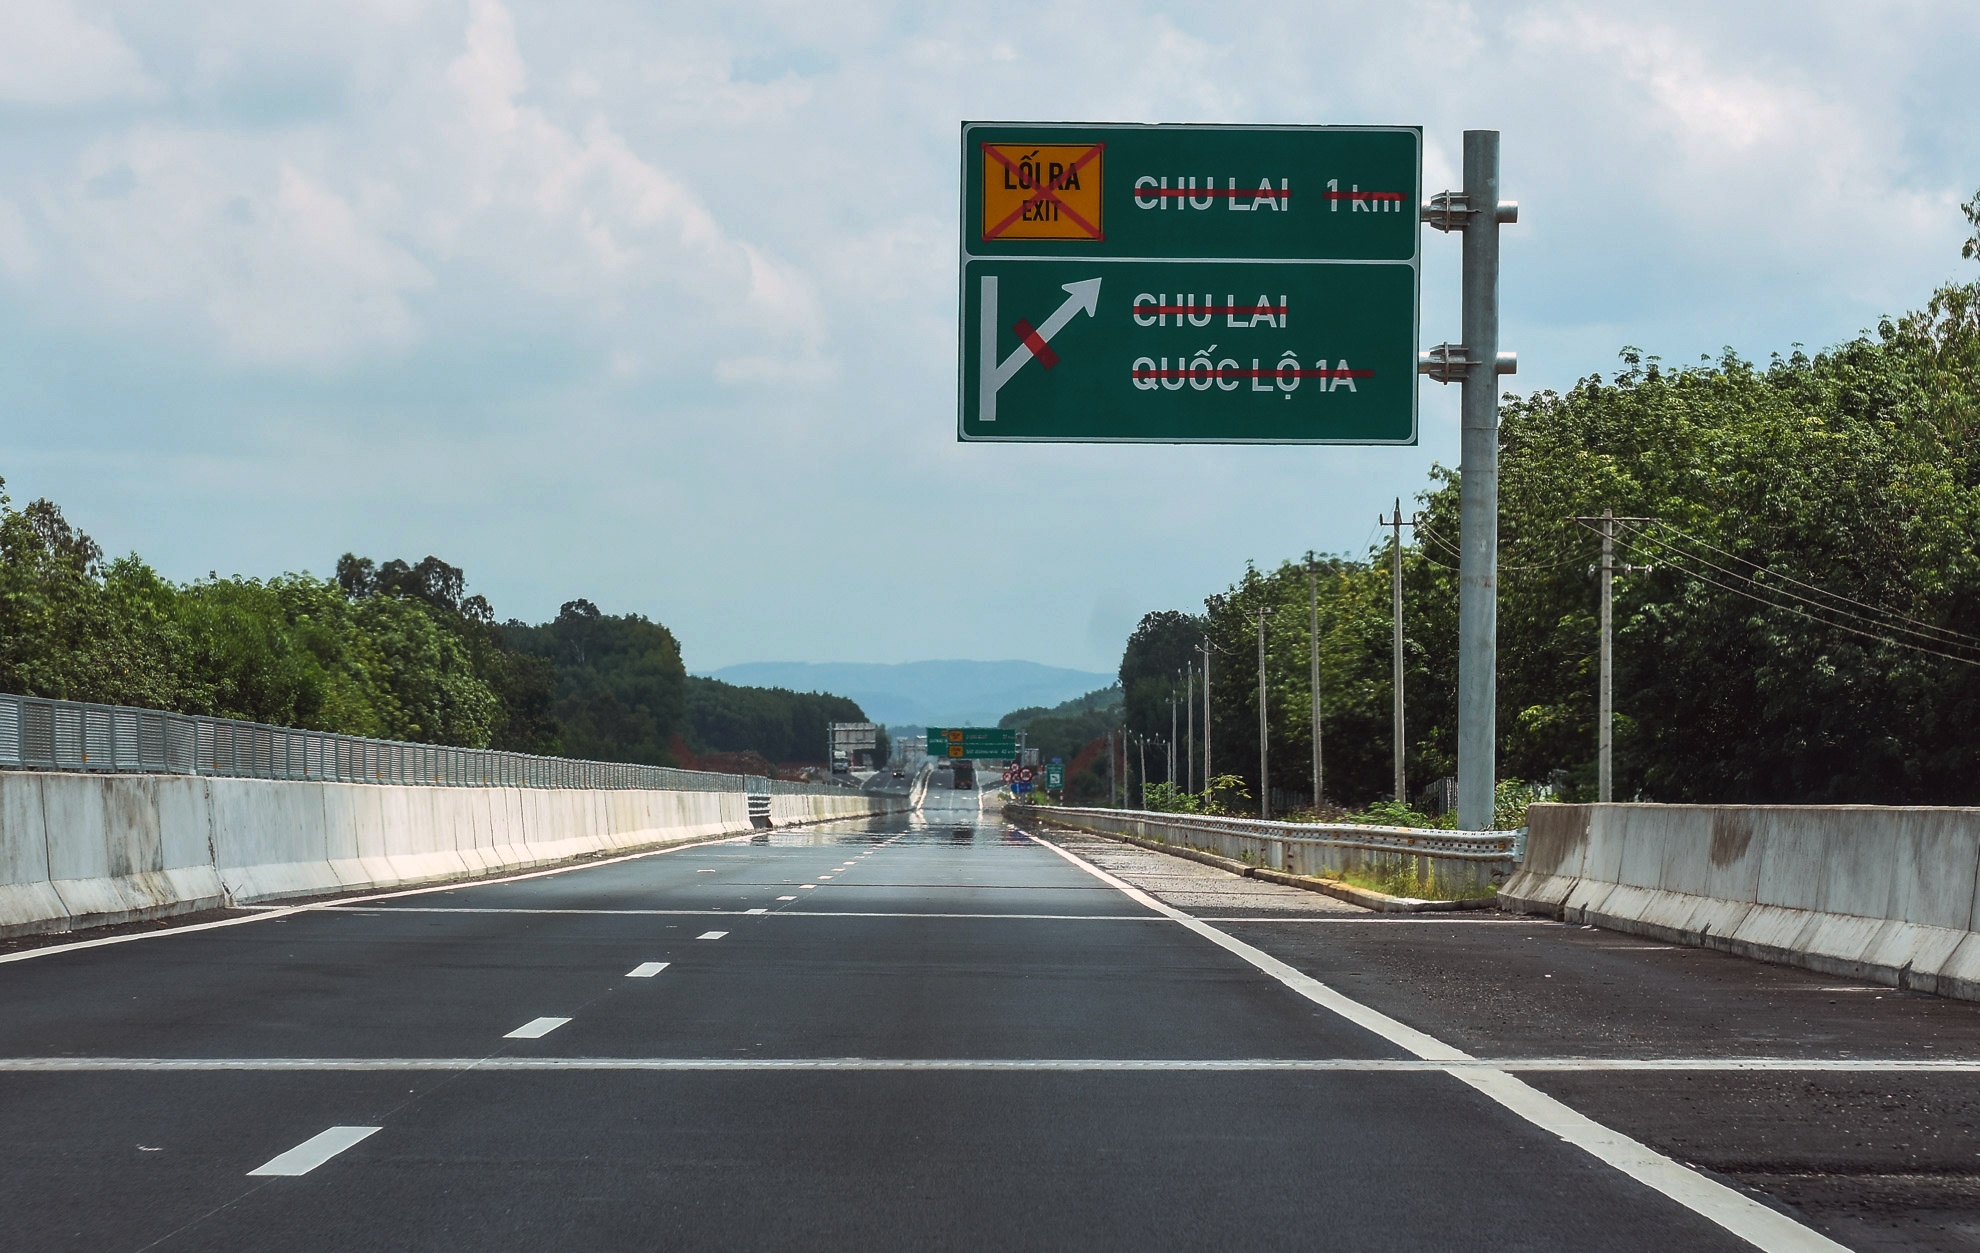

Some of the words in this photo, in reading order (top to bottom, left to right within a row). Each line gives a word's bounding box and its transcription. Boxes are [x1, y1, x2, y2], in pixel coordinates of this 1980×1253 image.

[1004, 150, 1041, 190] LỐI
[1048, 162, 1081, 191] RA
[1022, 199, 1062, 222] EXIT
[1134, 176, 1214, 210] CHU
[1228, 177, 1288, 212] LAI
[1326, 179, 1338, 212] 1
[1352, 184, 1401, 213] km
[1133, 293, 1212, 327] CHU
[1227, 294, 1287, 328] LAI
[1132, 344, 1240, 391] QUỐC
[1252, 350, 1301, 400] LỘ
[1315, 359, 1358, 393] 1A
